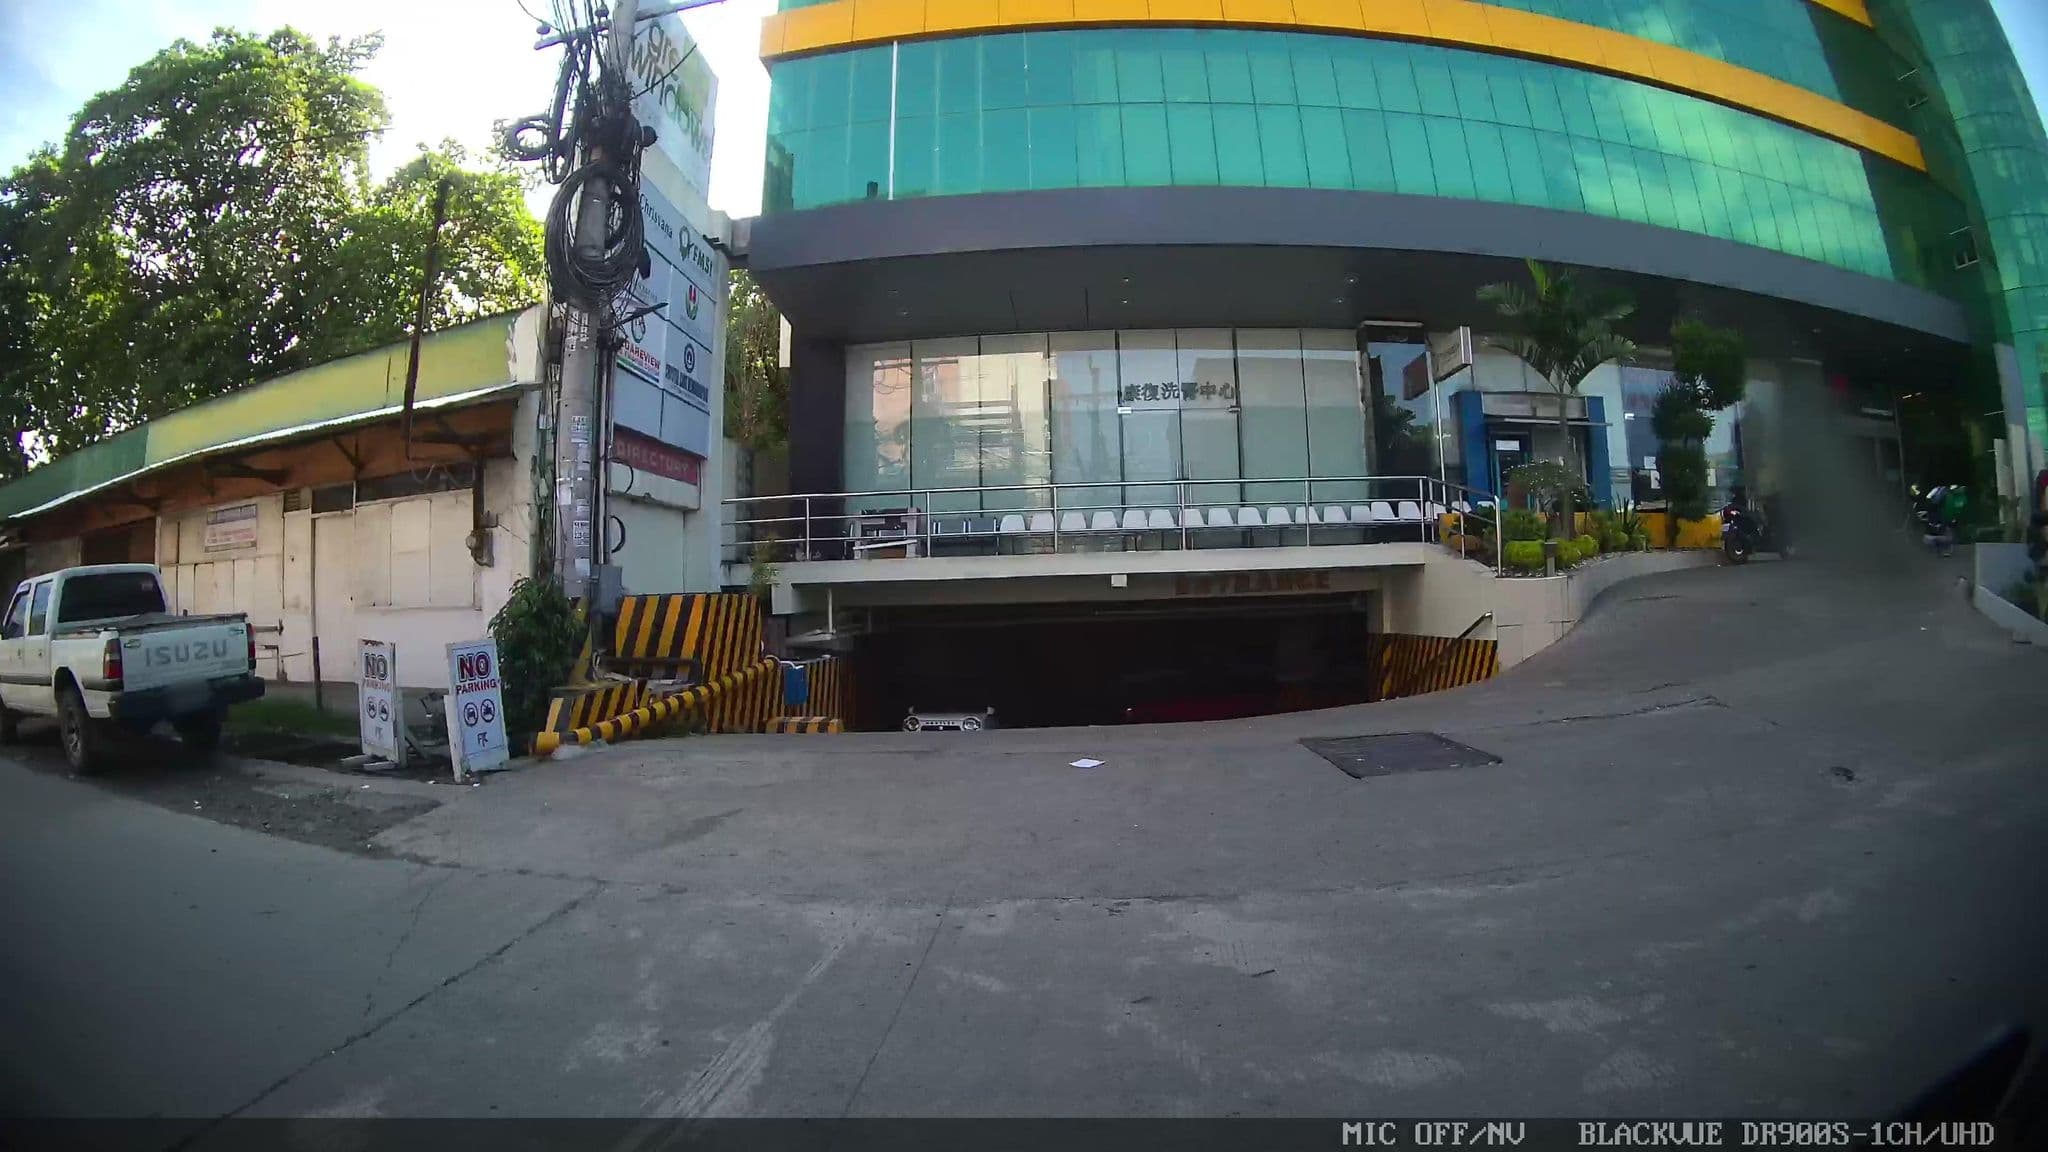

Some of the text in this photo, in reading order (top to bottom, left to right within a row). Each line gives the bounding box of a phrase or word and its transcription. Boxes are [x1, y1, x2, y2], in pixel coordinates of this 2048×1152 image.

[692, 245, 713, 278] FMSI
[616, 440, 690, 474] DIRECTORY
[145, 639, 228, 667] ISUZU
[363, 652, 388, 681] NO
[457, 651, 492, 682] NO
[456, 678, 497, 695] PARKING
